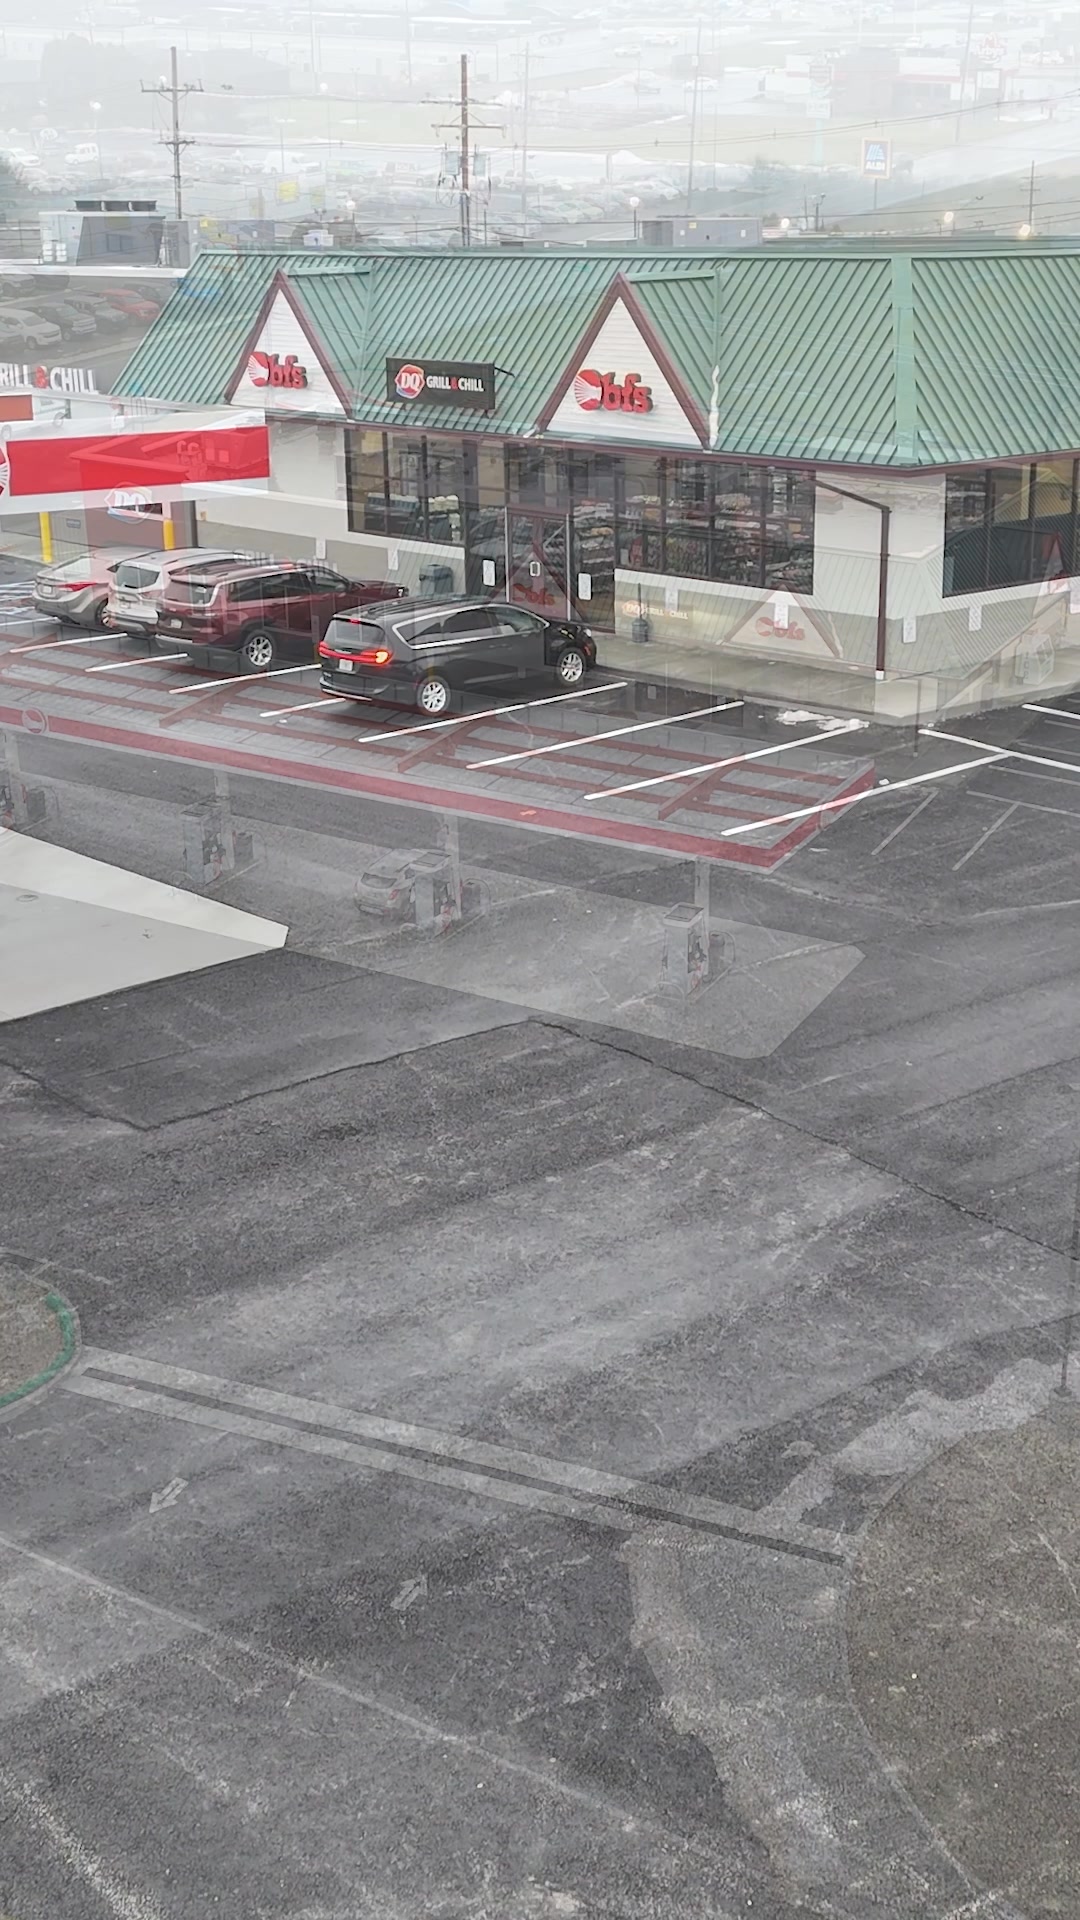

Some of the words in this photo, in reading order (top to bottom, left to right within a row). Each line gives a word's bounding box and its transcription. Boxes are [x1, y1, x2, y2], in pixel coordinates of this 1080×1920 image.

[865, 160, 885, 171] ALDI
[35, 365, 48, 389] &
[50, 367, 99, 395] CHILL
[269, 353, 308, 389] bfs
[401, 372, 421, 390] DQ
[426, 375, 451, 390] GRILL
[458, 377, 484, 392] CHILL
[601, 372, 653, 413] bfs
